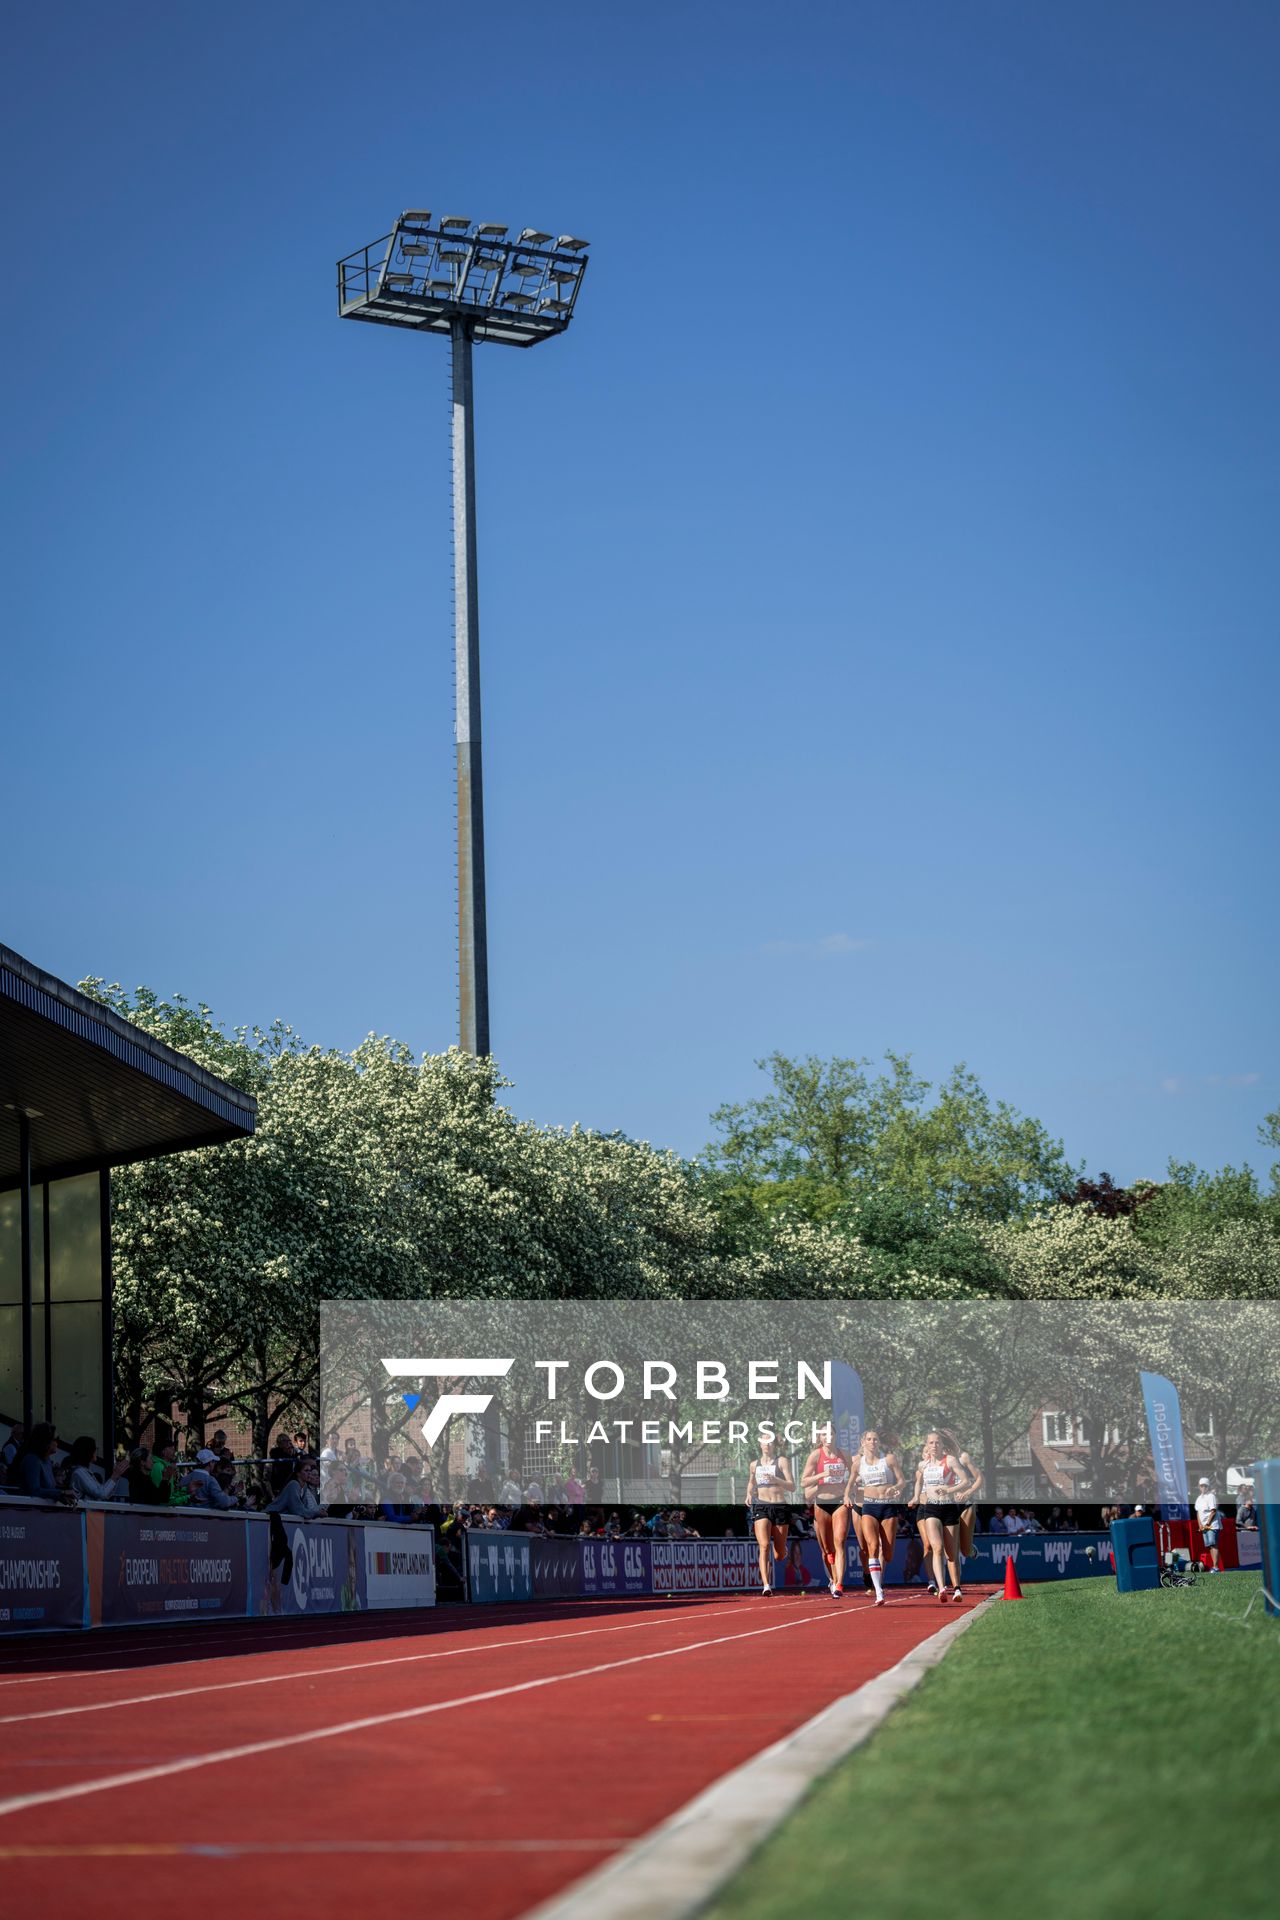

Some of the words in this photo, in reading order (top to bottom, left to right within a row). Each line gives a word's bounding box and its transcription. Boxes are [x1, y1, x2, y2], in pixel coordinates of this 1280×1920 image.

[309, 1538, 333, 1577] PLAN
[653, 1544, 671, 1565] LIQUI
[674, 1544, 693, 1565] LIQUI
[697, 1544, 717, 1565] LIQUI
[722, 1544, 744, 1565] LIQUI
[126, 1559, 159, 1585] EUROPEAN
[160, 1558, 189, 1584] ATHLETICS
[190, 1559, 232, 1583] CHAMPIONSHIPS
[655, 1567, 673, 1588] MOLY
[675, 1567, 695, 1588] MOLY
[697, 1567, 719, 1588] MOLY
[722, 1566, 744, 1587] MOLY
